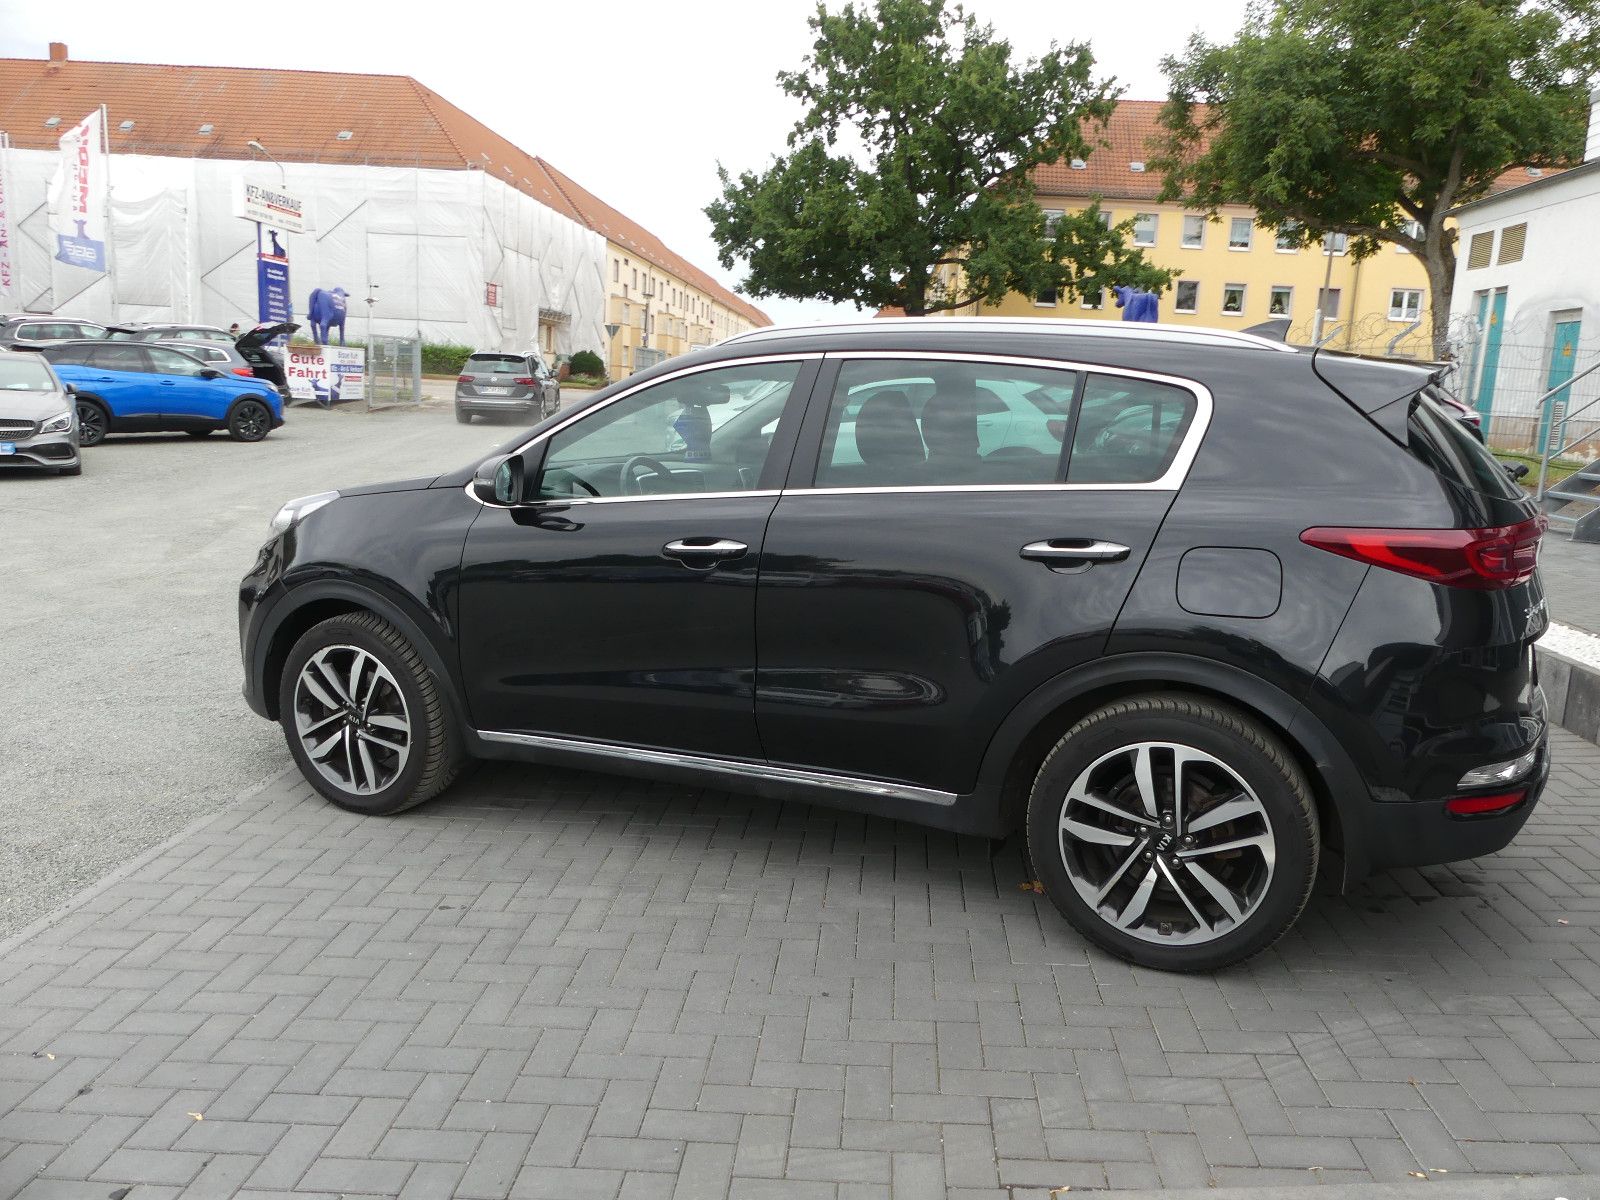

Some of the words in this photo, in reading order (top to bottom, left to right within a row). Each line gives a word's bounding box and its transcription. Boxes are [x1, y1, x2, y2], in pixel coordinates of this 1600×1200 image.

[290, 353, 325, 365] Gute
[288, 366, 327, 379] Fahrt
[1156, 833, 1173, 851] KIA
